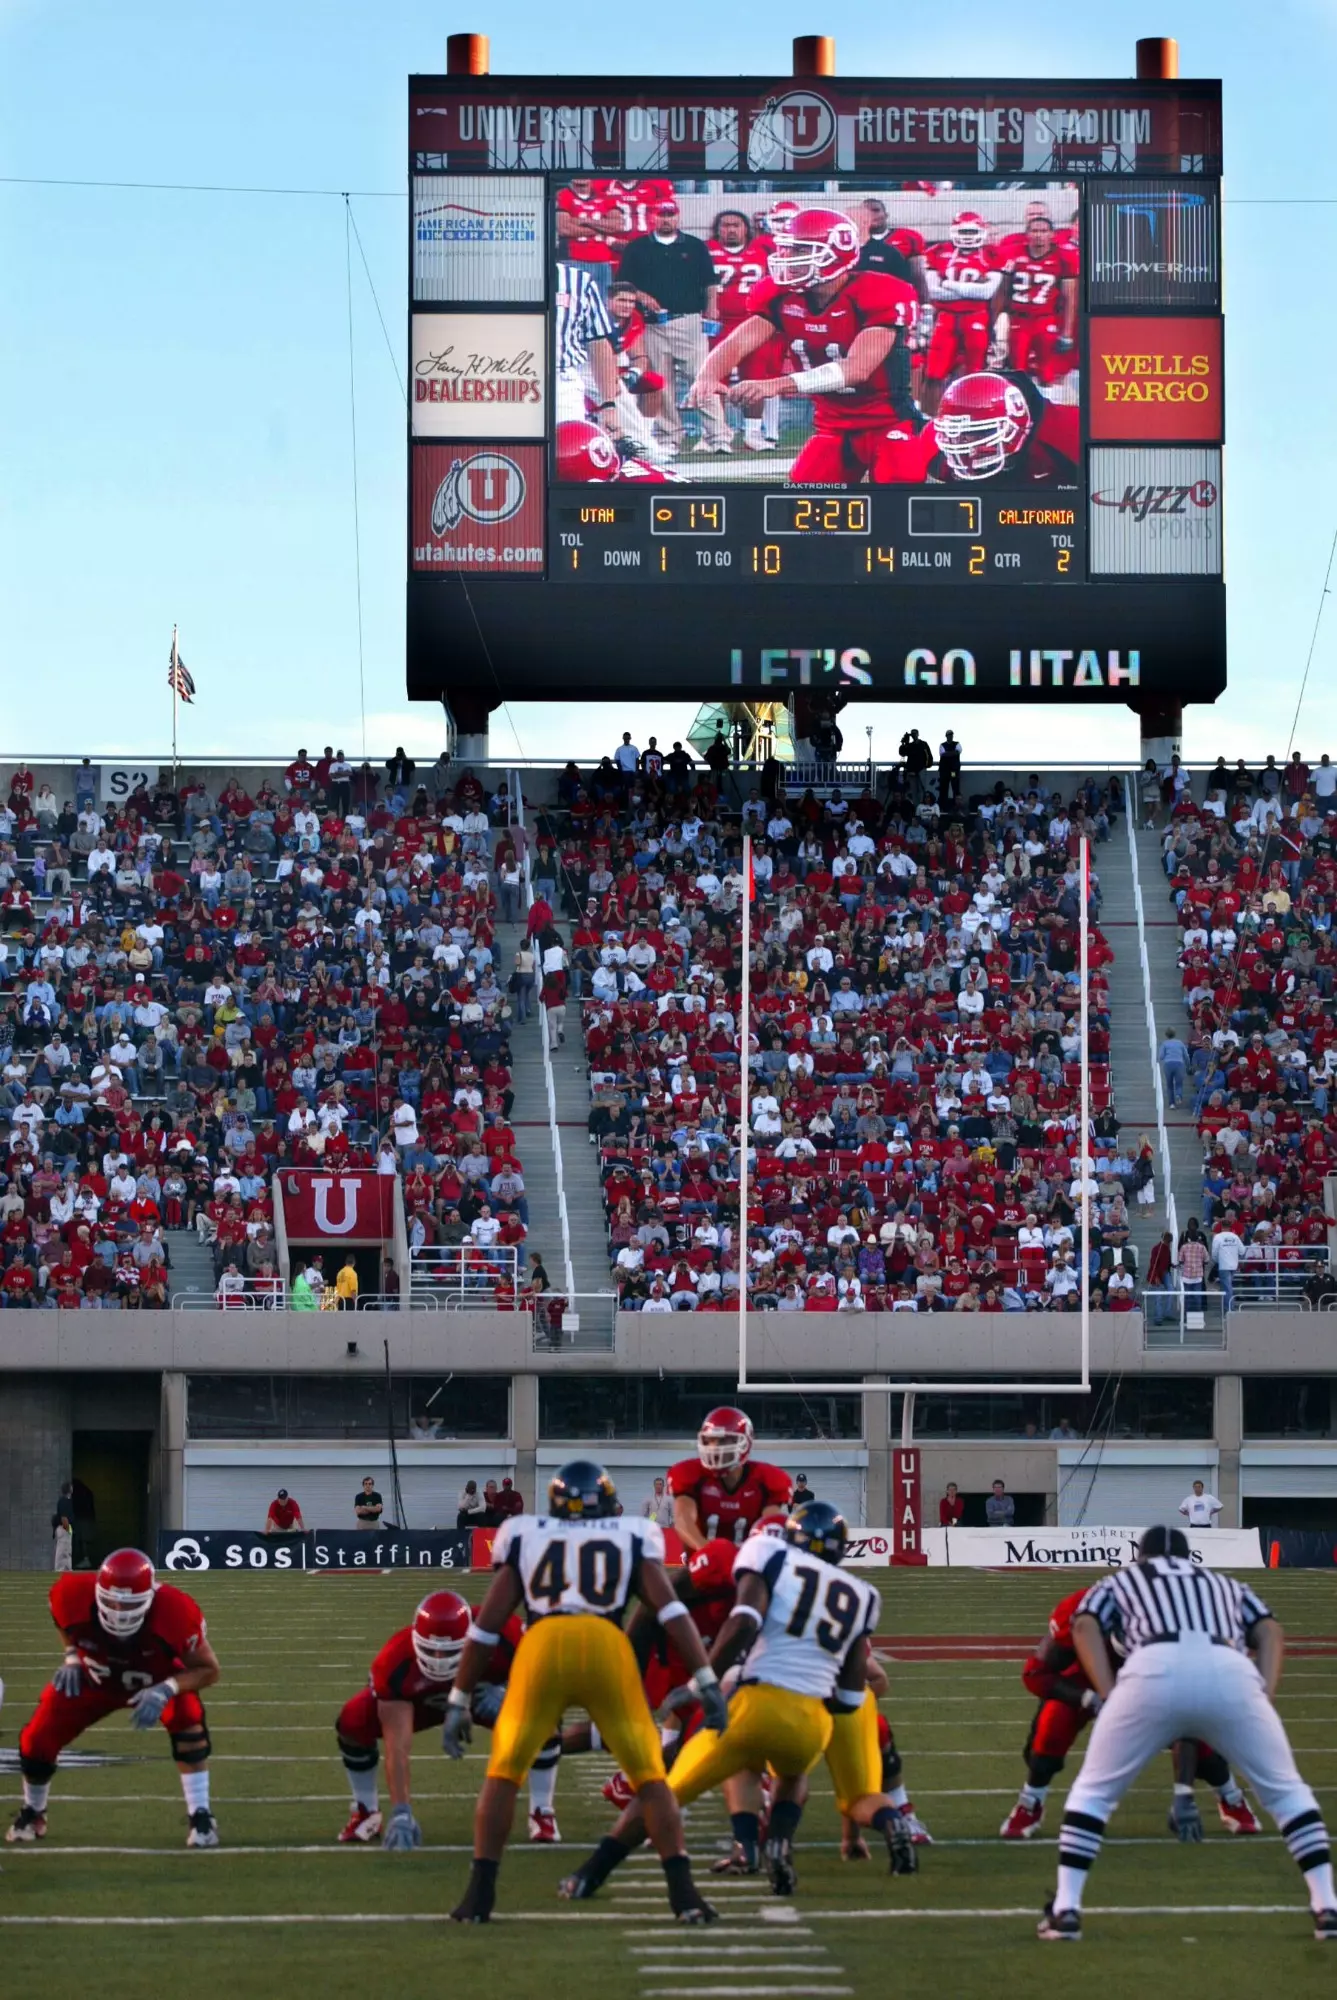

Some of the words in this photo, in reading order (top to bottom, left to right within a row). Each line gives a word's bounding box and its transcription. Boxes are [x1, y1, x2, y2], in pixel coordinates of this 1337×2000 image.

[459, 105, 617, 142] UNIVERSITY
[628, 107, 657, 143] OF
[671, 106, 736, 142] UTAH
[781, 104, 822, 147] U
[858, 106, 1023, 145] RICE-ECCLES
[1035, 107, 1151, 145] STADIUM
[417, 219, 485, 229] AMERICAN
[489, 219, 535, 229] FAMILY
[425, 230, 531, 240] INSURANCE
[713, 263, 763, 294] 72
[1011, 272, 1056, 304] 27
[481, 350, 537, 376] Miller
[1101, 355, 1210, 376] WELLS
[414, 378, 542, 403] DEALERSHIPS
[1104, 381, 1210, 403] FARGO
[466, 467, 510, 512] U
[782, 482, 848, 490] DAKTRONICS
[796, 500, 865, 529] 2:20
[1118, 485, 1193, 523] KJZZ
[1195, 482, 1214, 503] 14
[580, 508, 615, 523] UTAH
[690, 503, 718, 528] 14
[959, 502, 974, 530] 7
[998, 509, 1075, 525] CALIFORNIA
[560, 533, 584, 547] TOL
[1050, 534, 1075, 548] TOL
[1149, 517, 1213, 540] SPORTS
[413, 542, 543, 563] utahutes.com
[572, 548, 579, 570] 1
[603, 550, 641, 567] DOWN
[660, 546, 667, 572] 1
[696, 551, 712, 567] TO
[714, 550, 732, 567] GO
[752, 544, 781, 574] 10
[865, 546, 894, 573] 14
[902, 551, 932, 567] BALL
[934, 551, 951, 567] ON
[968, 545, 985, 575] 2
[994, 552, 1021, 568] QTR
[1056, 549, 1071, 572] 2
[904, 648, 977, 686] GO
[310, 1178, 362, 1234] U
[901, 1453, 916, 1550] UTAH
[706, 1513, 748, 1549] 11
[1071, 1530, 1137, 1540] DESERET
[225, 1544, 293, 1568] SOS
[315, 1543, 454, 1568] Staffing
[1005, 1539, 1122, 1567] Morning
[529, 1539, 622, 1608] 40
